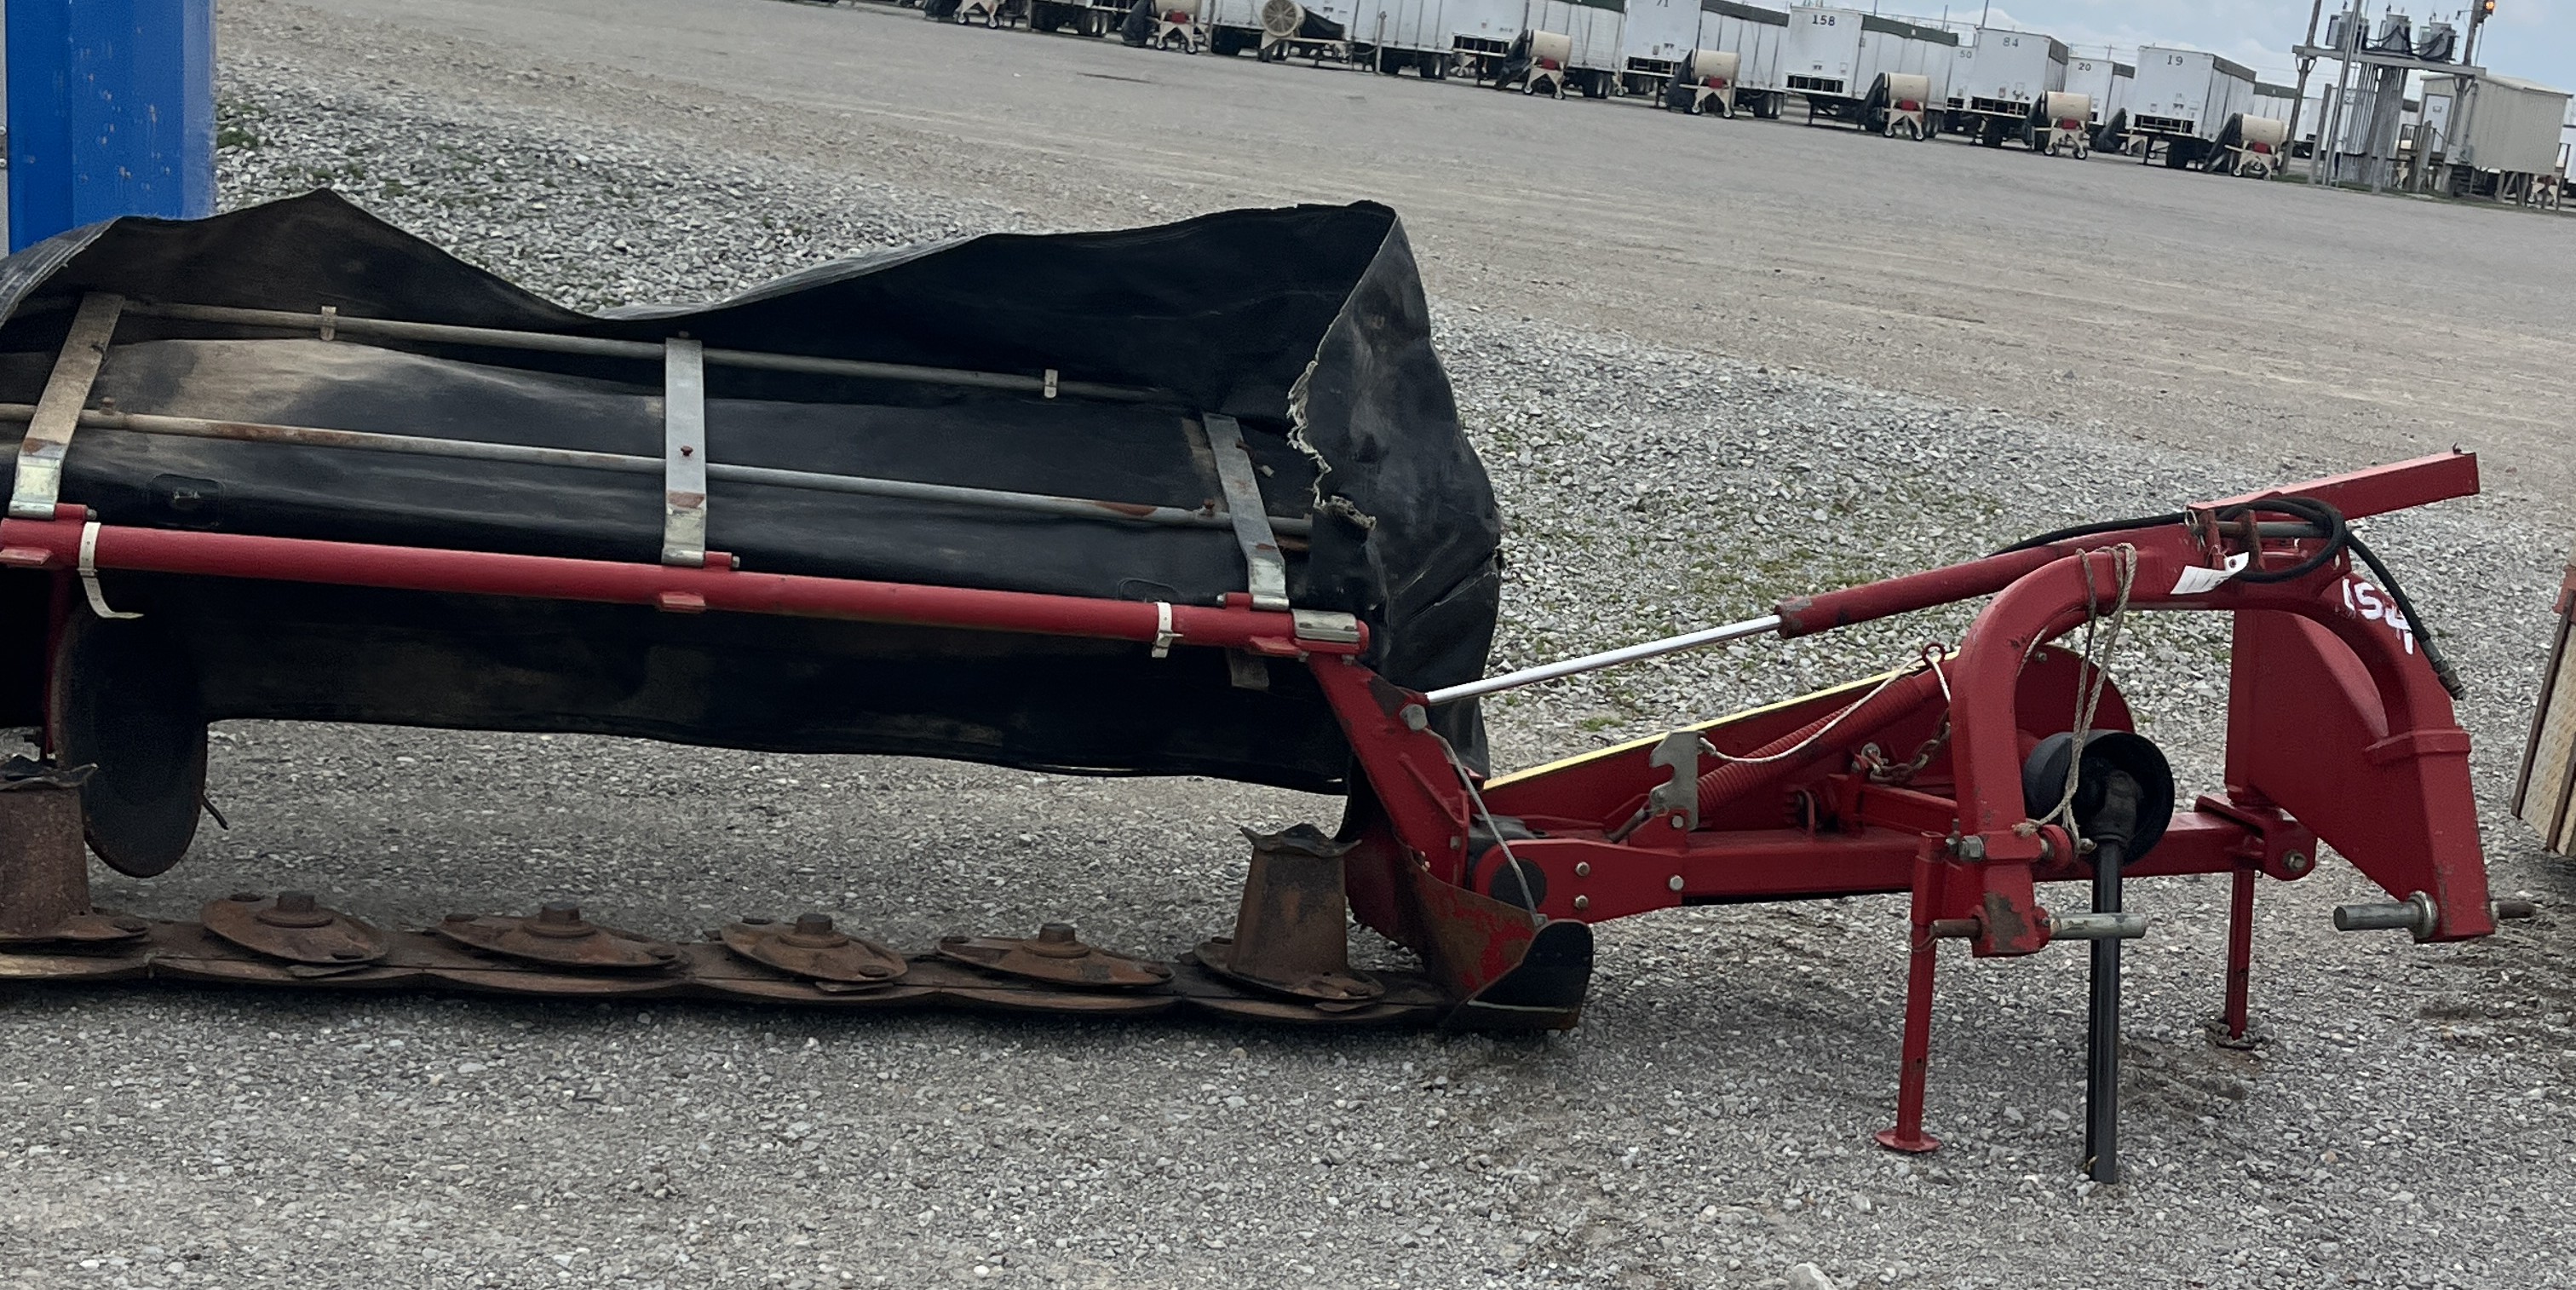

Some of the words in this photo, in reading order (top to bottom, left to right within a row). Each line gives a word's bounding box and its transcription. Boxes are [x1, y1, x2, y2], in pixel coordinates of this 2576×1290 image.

[1812, 14, 1835, 26] 158
[2003, 37, 2019, 47] 84
[2167, 55, 2183, 66] 19
[2078, 62, 2091, 71] 20
[2343, 578, 2413, 654] 154
